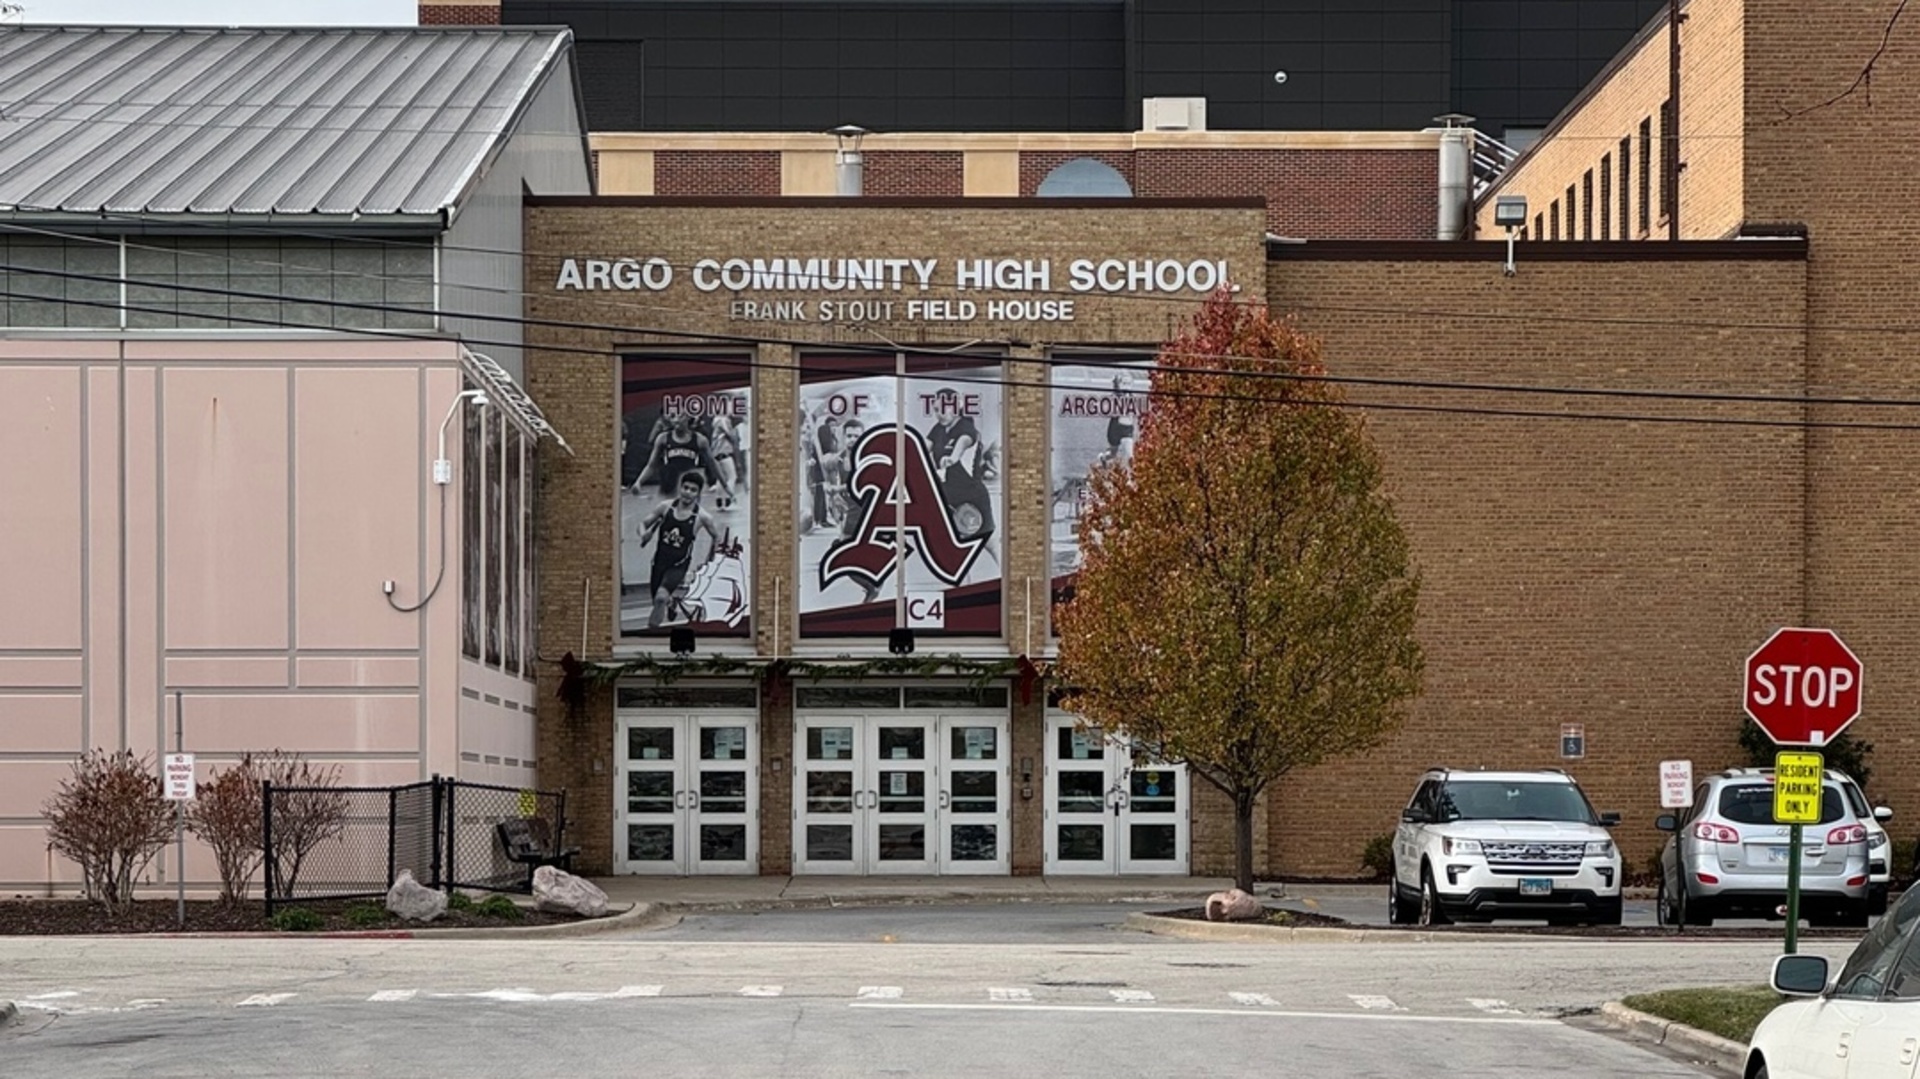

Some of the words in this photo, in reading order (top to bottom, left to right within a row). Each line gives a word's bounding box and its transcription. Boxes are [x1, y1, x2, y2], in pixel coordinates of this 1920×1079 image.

[555, 257, 673, 291] ARGO
[692, 257, 938, 292] COMMUNITY
[956, 258, 1050, 292] HIGH
[1069, 258, 1241, 292] SCHOOL
[730, 300, 806, 321] FRANK
[818, 300, 895, 321] STOUT
[907, 300, 977, 321] FIELD
[987, 300, 1075, 321] HOUSE
[663, 395, 747, 417] HOME
[828, 395, 869, 417] OF
[919, 394, 981, 416] THE
[1060, 396, 1150, 416] ARGONAU
[908, 598, 943, 621] C4
[1753, 664, 1854, 708] STOP
[1779, 764, 1820, 779] RESIDENT
[1779, 782, 1818, 797] PARKING
[1784, 799, 1810, 814] ONLY
